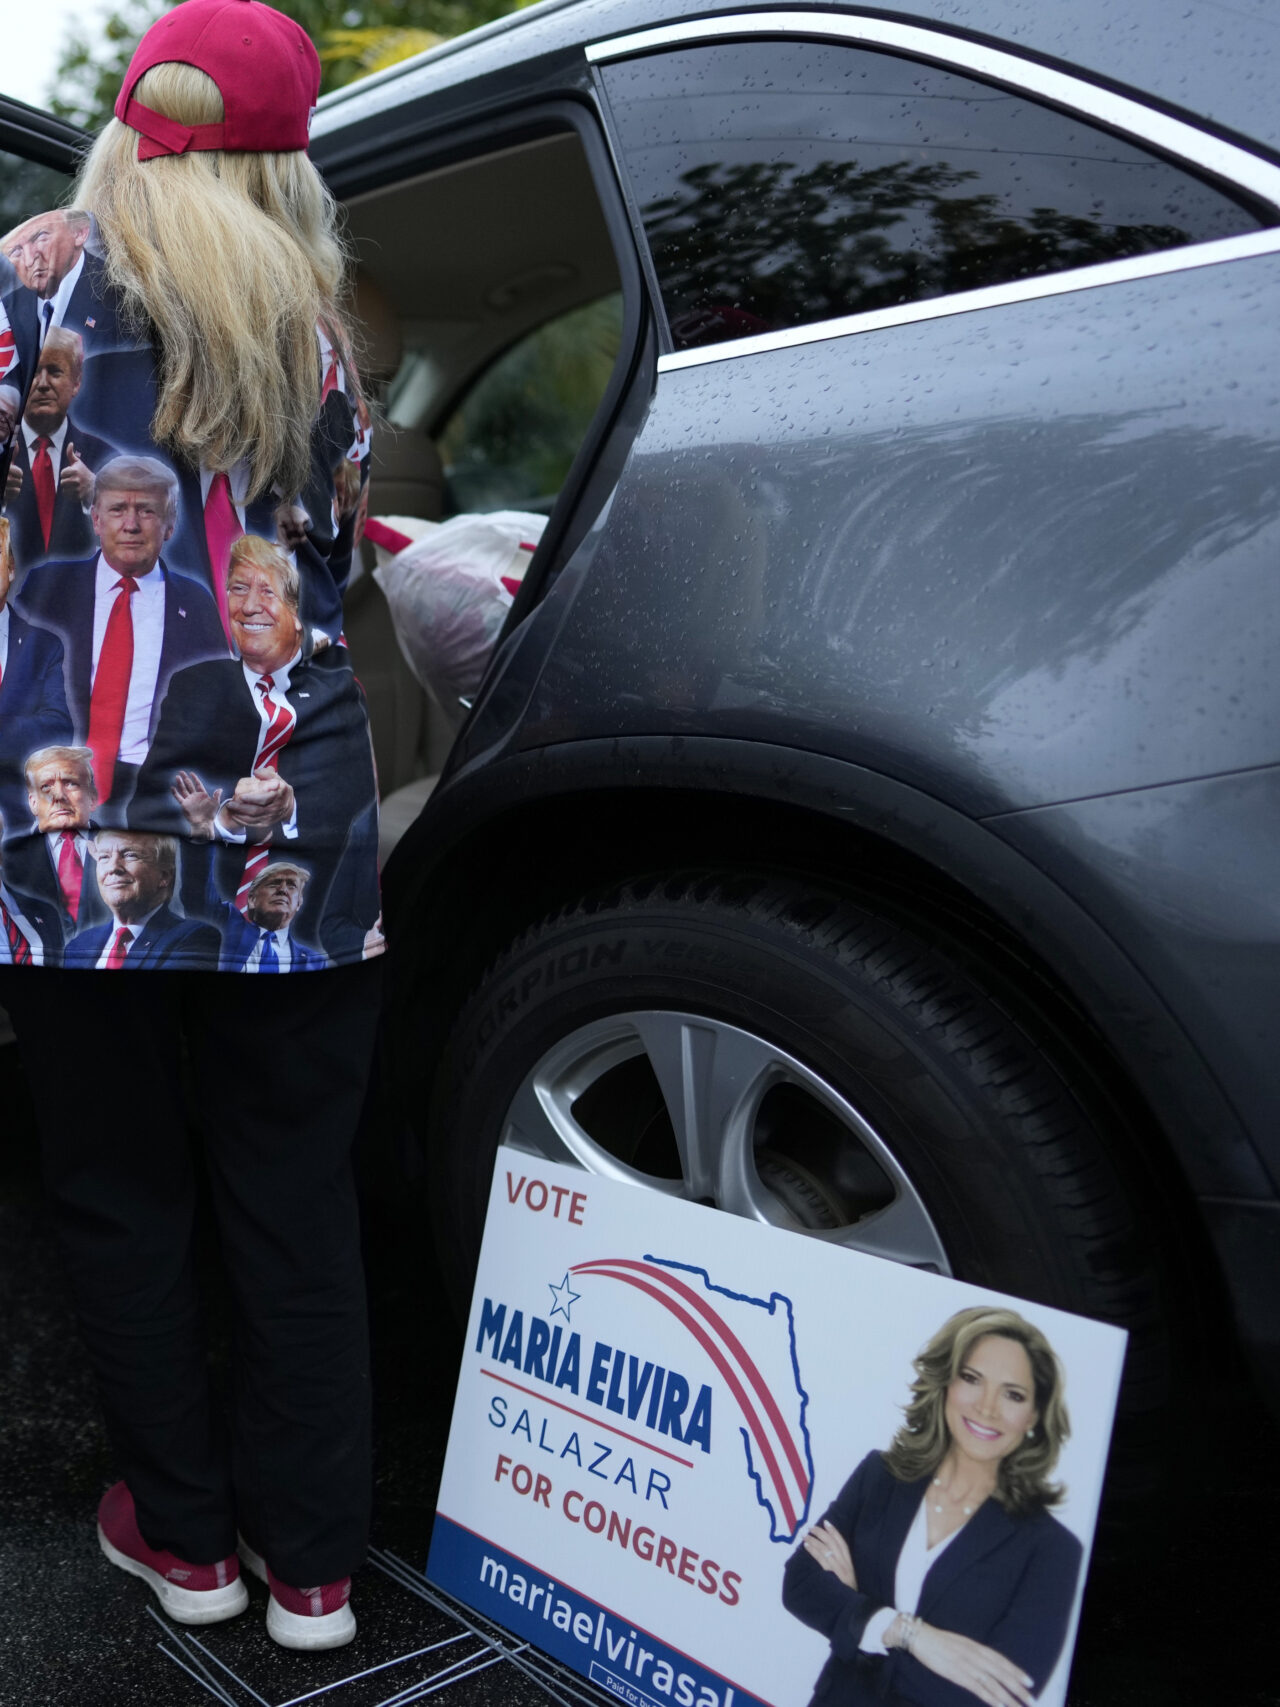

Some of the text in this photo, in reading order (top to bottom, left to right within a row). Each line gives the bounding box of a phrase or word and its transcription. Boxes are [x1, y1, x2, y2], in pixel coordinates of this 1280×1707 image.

[505, 1171, 587, 1226] VOTE
[475, 1297, 713, 1454] MARIA ELVIRA
[488, 1395, 672, 1510] SALAZAR
[494, 1453, 743, 1606] FOR CONGRESS
[606, 1675, 625, 1695] Paid
[625, 1688, 639, 1703] for
